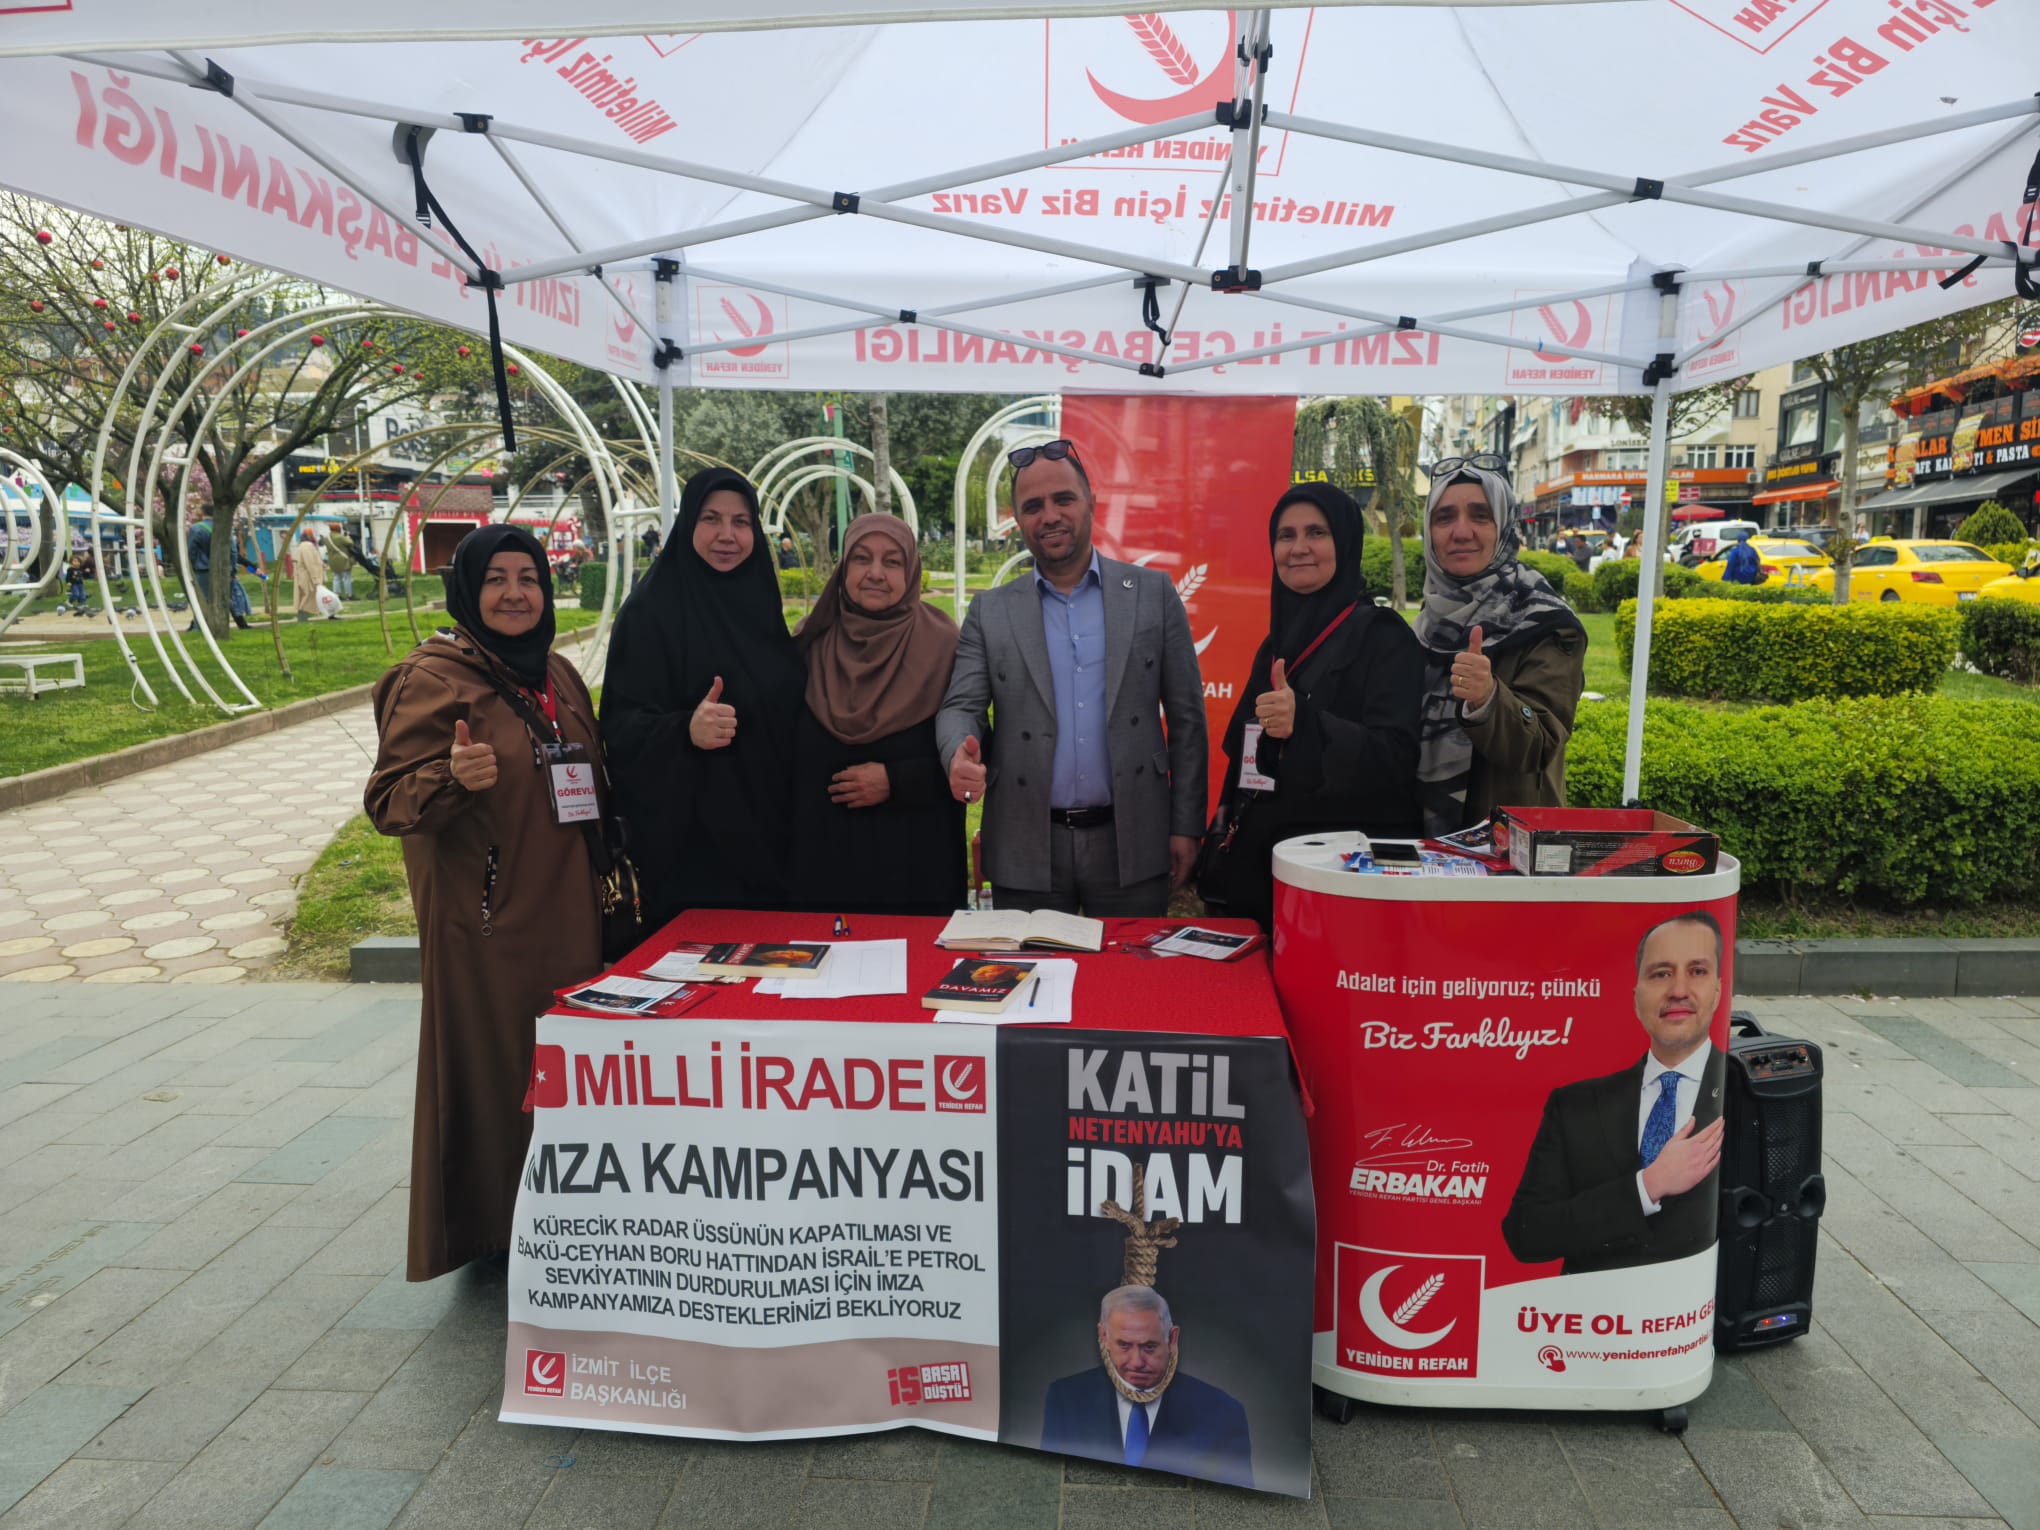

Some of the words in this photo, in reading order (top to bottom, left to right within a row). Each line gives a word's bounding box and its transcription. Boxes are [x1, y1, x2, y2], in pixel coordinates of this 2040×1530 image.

[1336, 970, 1397, 993] Adalet
[1401, 975, 1437, 998] için
[1442, 978, 1536, 1000] geliyoruz;
[1541, 978, 1601, 1001] çünkü
[1359, 1021, 1418, 1050] Biz
[1421, 1016, 1574, 1060] Farklıyız!
[574, 1040, 723, 1108] MİLLİ
[741, 1041, 926, 1111] İRADE
[1068, 1115, 1243, 1149] NETENYAHU'YA
[525, 1142, 632, 1194] MZA
[641, 1142, 985, 1203] KAMPANYASI
[1426, 1159, 1447, 1173] Dr.
[1451, 1161, 1490, 1174] Fatih
[1349, 1167, 1488, 1199] ERBAKAN
[533, 1214, 619, 1237] KÜRECİK
[623, 1219, 689, 1241] RADAR
[693, 1219, 784, 1247] ÜSSÜNÜN
[789, 1223, 922, 1246] KAPATILMASI
[925, 1224, 952, 1244] VE
[517, 1235, 646, 1265] BAKÜ-CEYHAN
[650, 1245, 702, 1268] BORU
[706, 1250, 817, 1273] HATTINDAN
[907, 1250, 986, 1273] PETROL
[545, 1264, 672, 1290] SEVKİYATININ
[676, 1273, 829, 1298] DURDURULMASI
[834, 1269, 872, 1298] İÇİN
[876, 1269, 924, 1293] İMZA
[527, 1288, 675, 1317] KAMPANYAMIZA
[679, 1295, 831, 1326] DESTEKLERİNİZİ
[836, 1295, 962, 1320] BEKLİYORUZ
[1517, 1306, 1583, 1334] ÜYE
[1591, 1314, 1633, 1335] OL
[1641, 1310, 1697, 1334] REFAH
[571, 1353, 620, 1377] İZMİT
[630, 1359, 672, 1384] İLÇE
[921, 1364, 960, 1384] BAŞA
[1345, 1347, 1415, 1372] YENİDEN
[1418, 1356, 1469, 1372] REFAH
[570, 1382, 687, 1409] BAŞKANLIĞI
